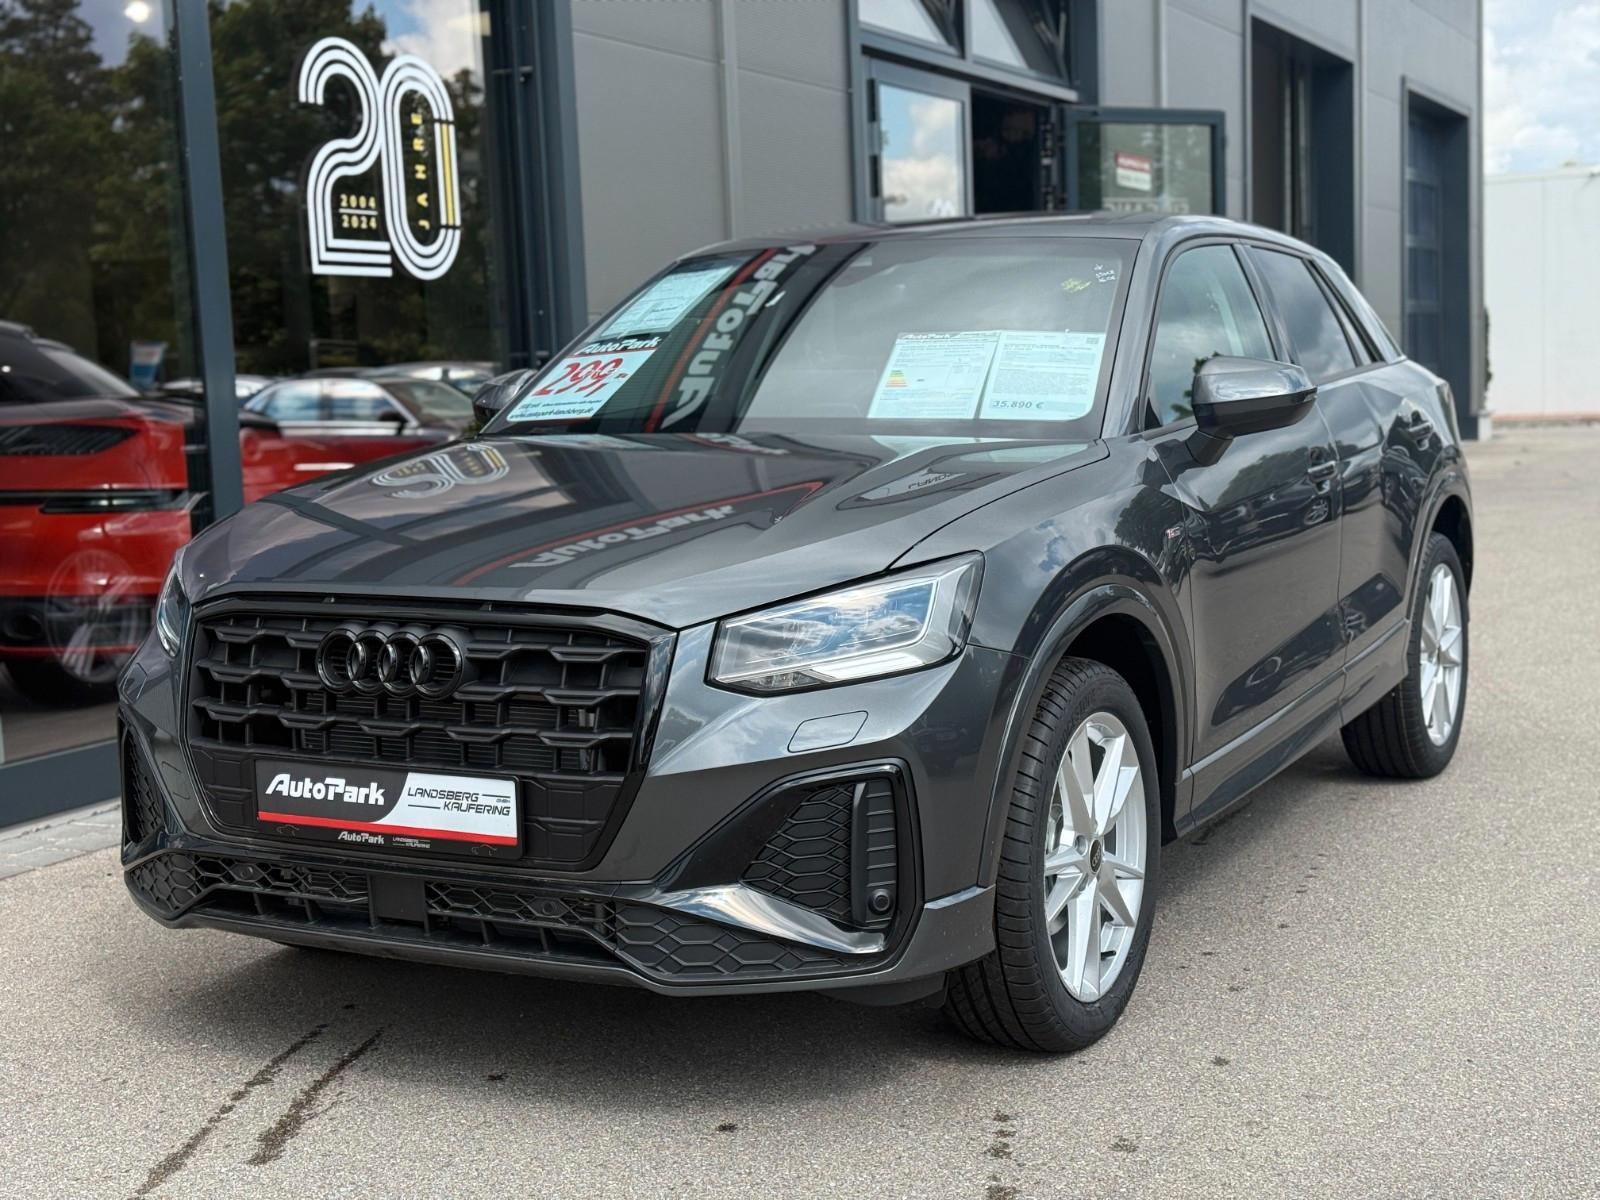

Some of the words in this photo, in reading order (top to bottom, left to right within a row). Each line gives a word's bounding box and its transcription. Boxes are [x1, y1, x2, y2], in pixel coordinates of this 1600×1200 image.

[298, 36, 462, 281] 20
[410, 112, 430, 230] JAHRE
[339, 193, 377, 209] 2004
[341, 214, 377, 229] 2024
[992, 400, 1033, 409] 35.890
[1036, 401, 1045, 409] €
[265, 773, 385, 806] AutoPark
[407, 786, 480, 802] LANDSBERG
[443, 800, 511, 817] KAUFERING
[337, 830, 385, 845] AutoPark
